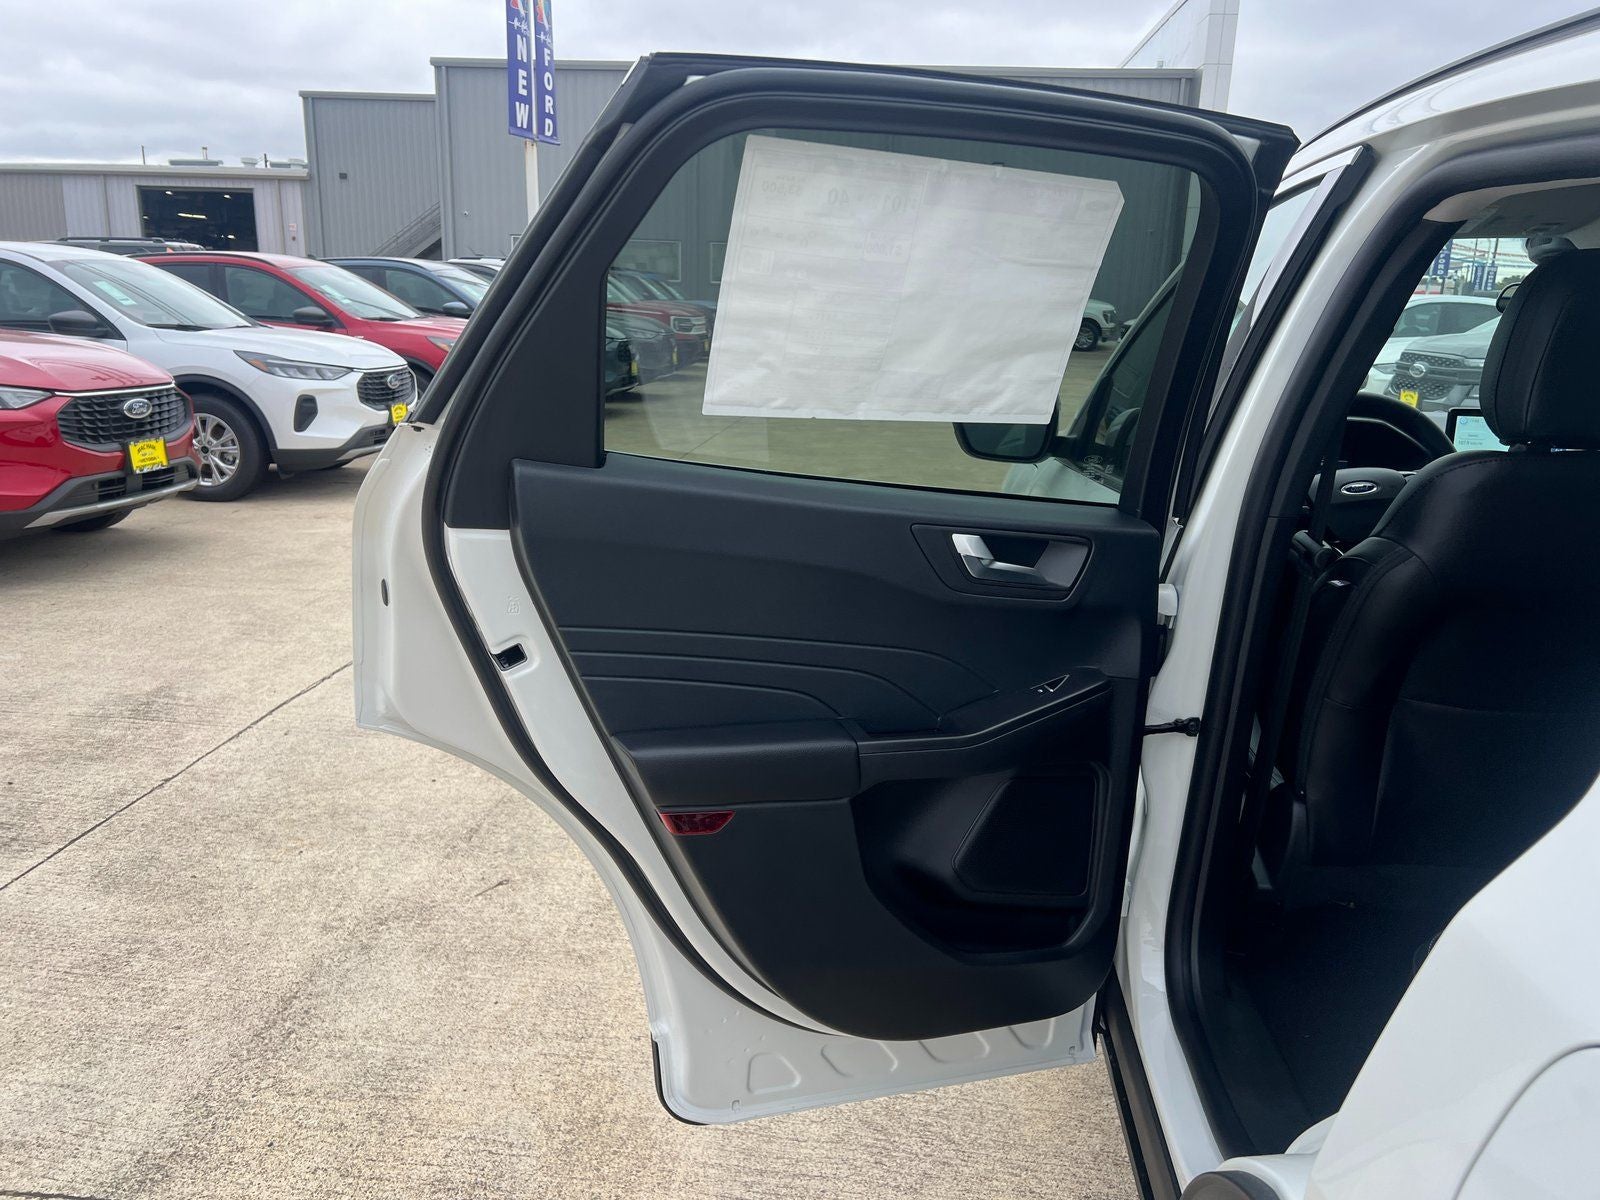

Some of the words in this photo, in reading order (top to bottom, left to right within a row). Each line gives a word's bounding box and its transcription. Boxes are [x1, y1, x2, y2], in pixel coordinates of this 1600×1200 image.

[515, 33, 529, 129] NEW
[543, 47, 554, 137] FORD
[1437, 253, 1446, 275] FORD
